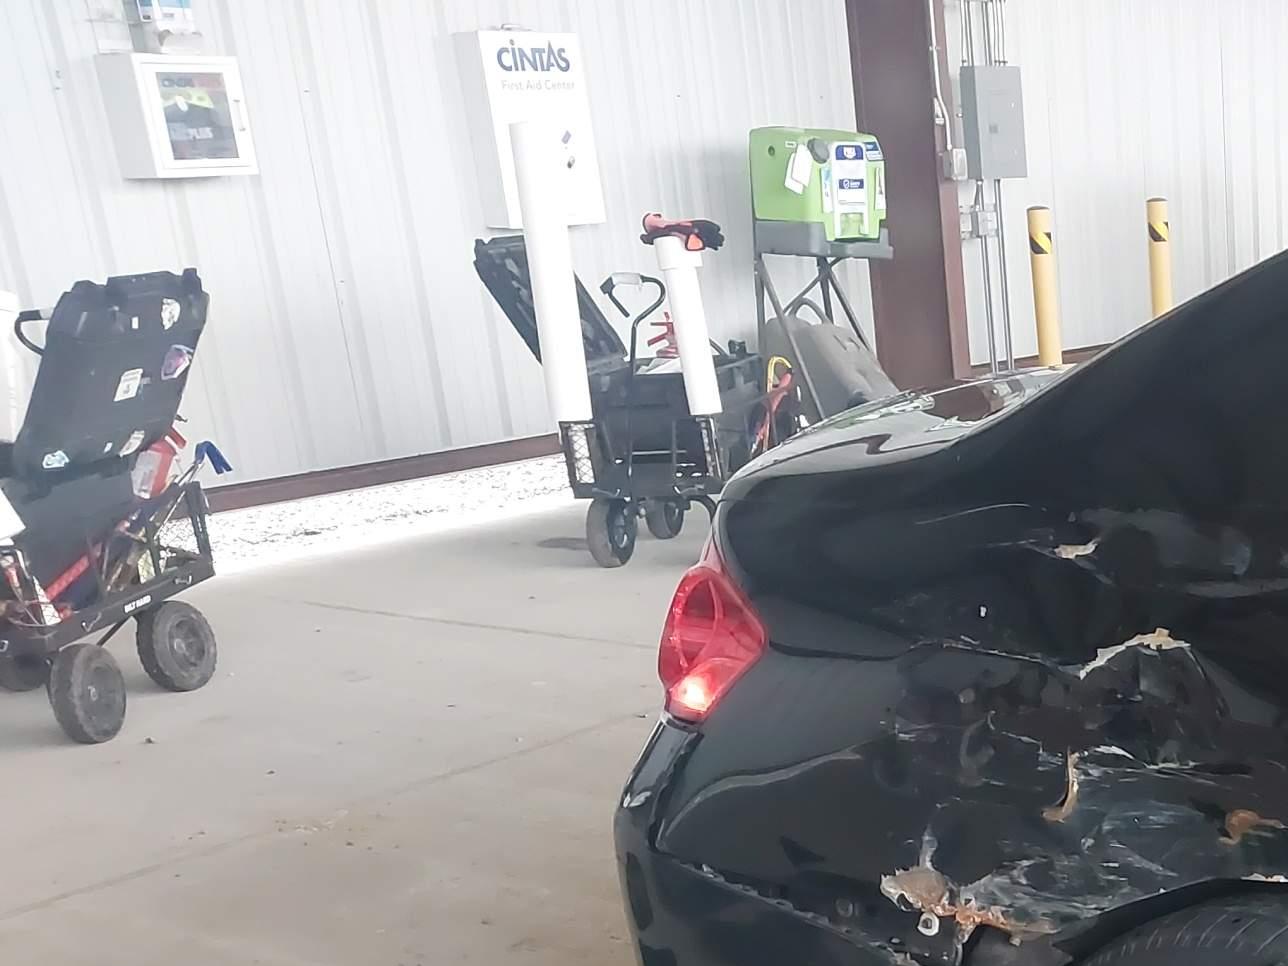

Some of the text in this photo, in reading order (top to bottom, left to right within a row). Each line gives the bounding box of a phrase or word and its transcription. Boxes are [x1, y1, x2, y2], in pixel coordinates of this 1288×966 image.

[496, 38, 571, 73] CINTAS
[502, 79, 575, 91] First Aid Center
